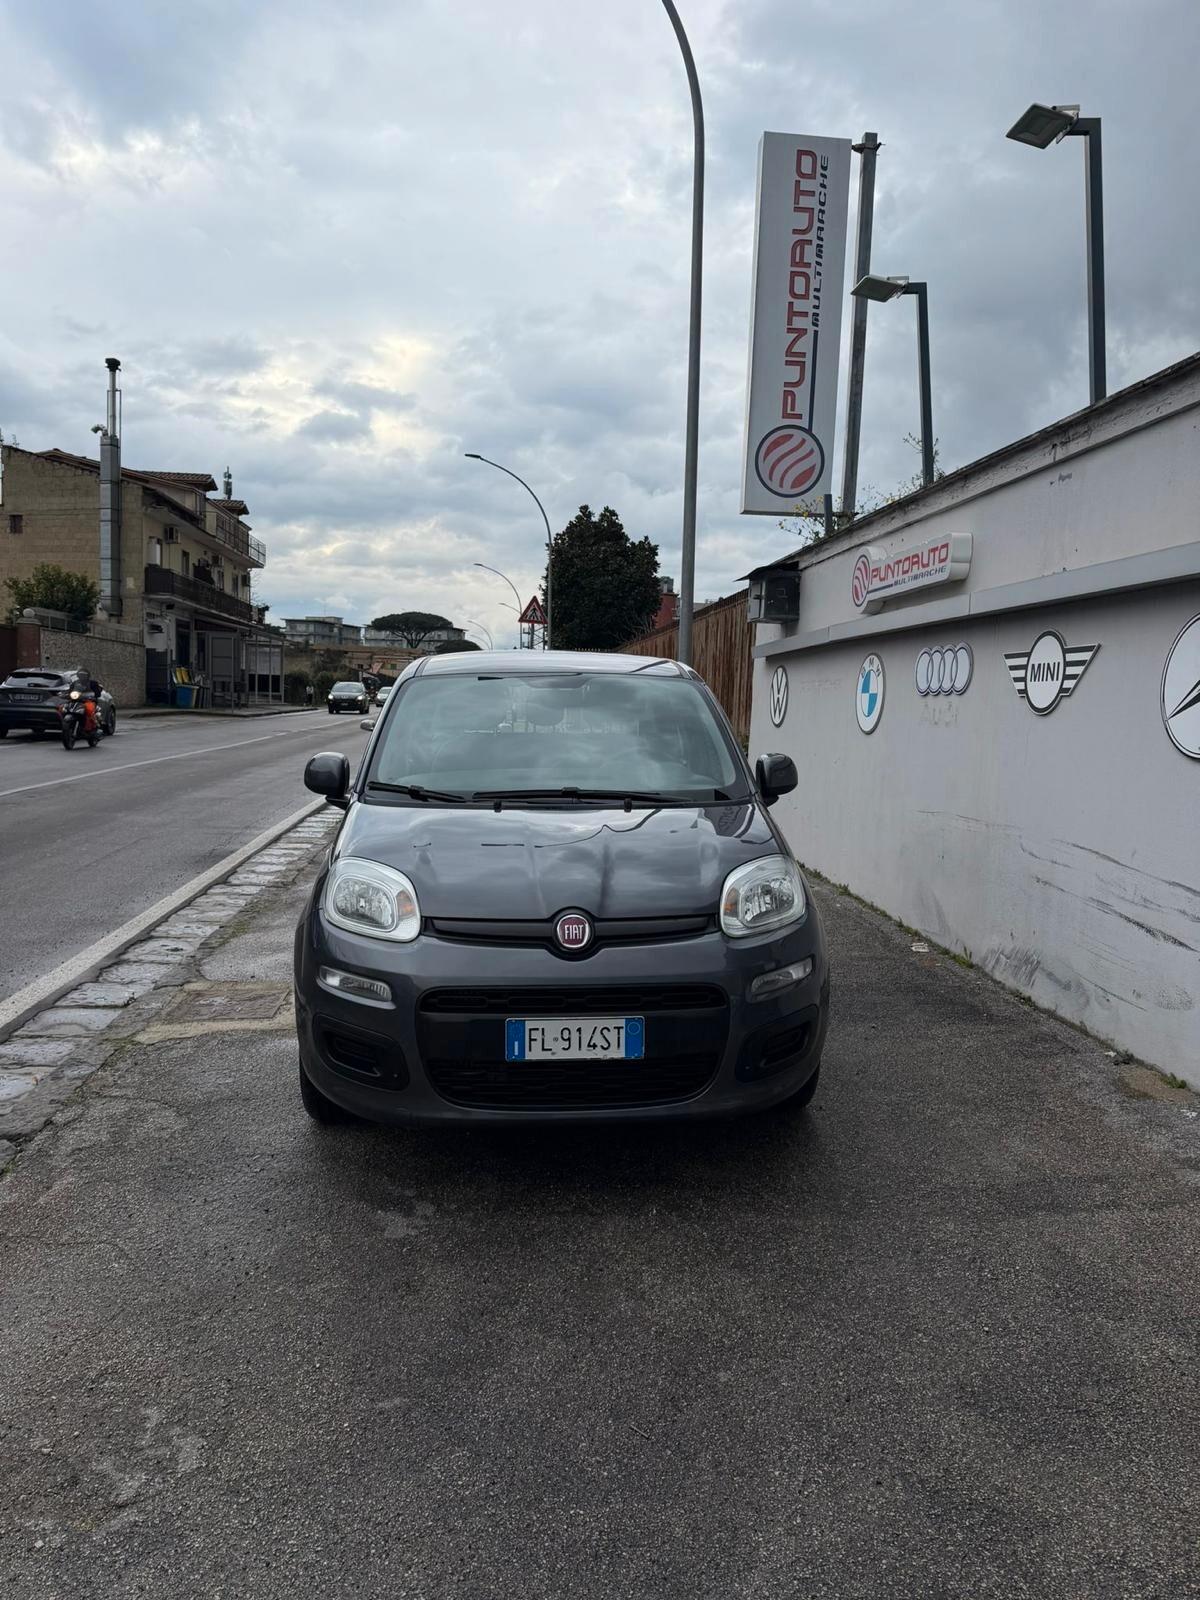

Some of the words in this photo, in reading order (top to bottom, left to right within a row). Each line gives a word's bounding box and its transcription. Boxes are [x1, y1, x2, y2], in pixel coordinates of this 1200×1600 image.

[811, 154, 830, 328] MULTIMARCHE
[782, 149, 818, 420] PUNTOAUTO
[870, 542, 949, 585] PUNTOAUTO
[893, 565, 947, 587] MULTIMARCHE
[861, 657, 882, 678] BMW
[1029, 661, 1061, 683] MINI
[564, 924, 584, 940] FIAT
